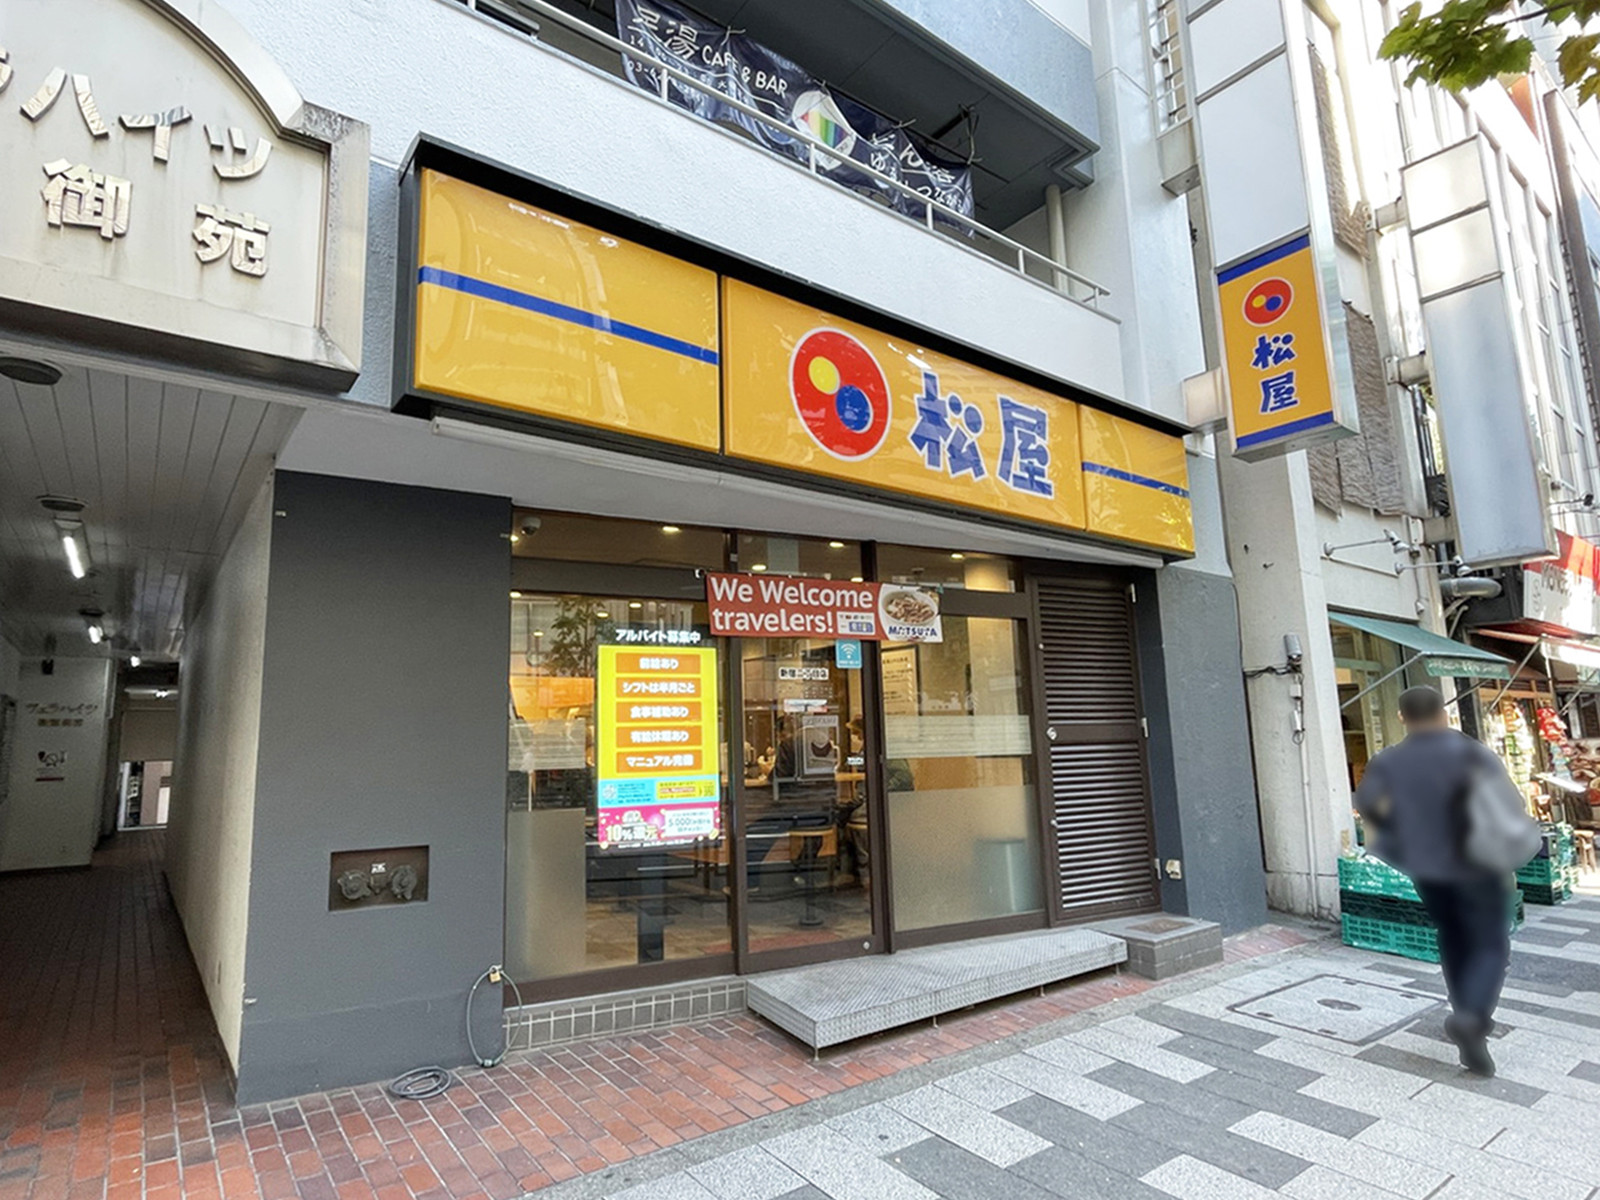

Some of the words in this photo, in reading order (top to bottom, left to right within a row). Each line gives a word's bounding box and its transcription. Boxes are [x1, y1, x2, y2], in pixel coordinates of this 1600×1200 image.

[741, 66, 751, 83] &
[755, 70, 788, 99] BAR
[41, 158, 270, 277] 御苑
[1251, 332, 1299, 415] 松屋
[907, 368, 1054, 500] 松屋
[710, 577, 754, 603] We
[759, 579, 874, 609] Welcome
[615, 628, 701, 644] アルバイト募集中
[712, 608, 834, 634] travelers!
[622, 681, 696, 694] シフトは半月ごと
